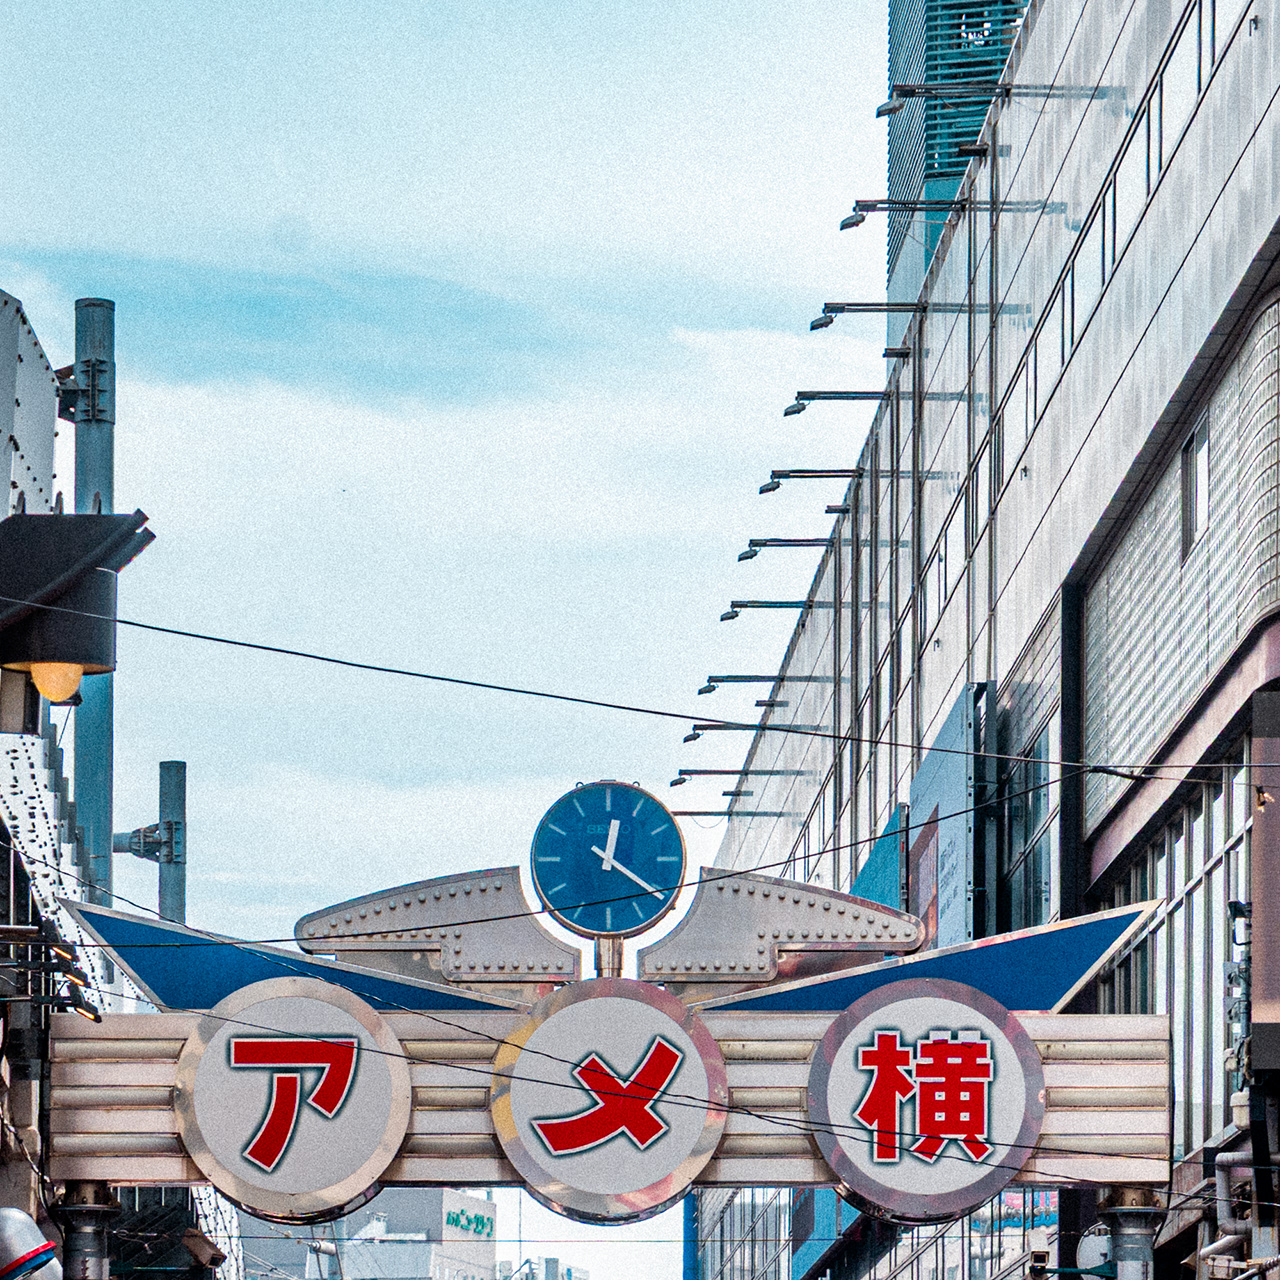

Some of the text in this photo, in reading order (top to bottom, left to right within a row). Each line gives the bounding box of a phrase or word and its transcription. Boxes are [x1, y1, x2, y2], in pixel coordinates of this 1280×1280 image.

[586, 824, 631, 834] SEO
[224, 1030, 995, 1172] アメ横
